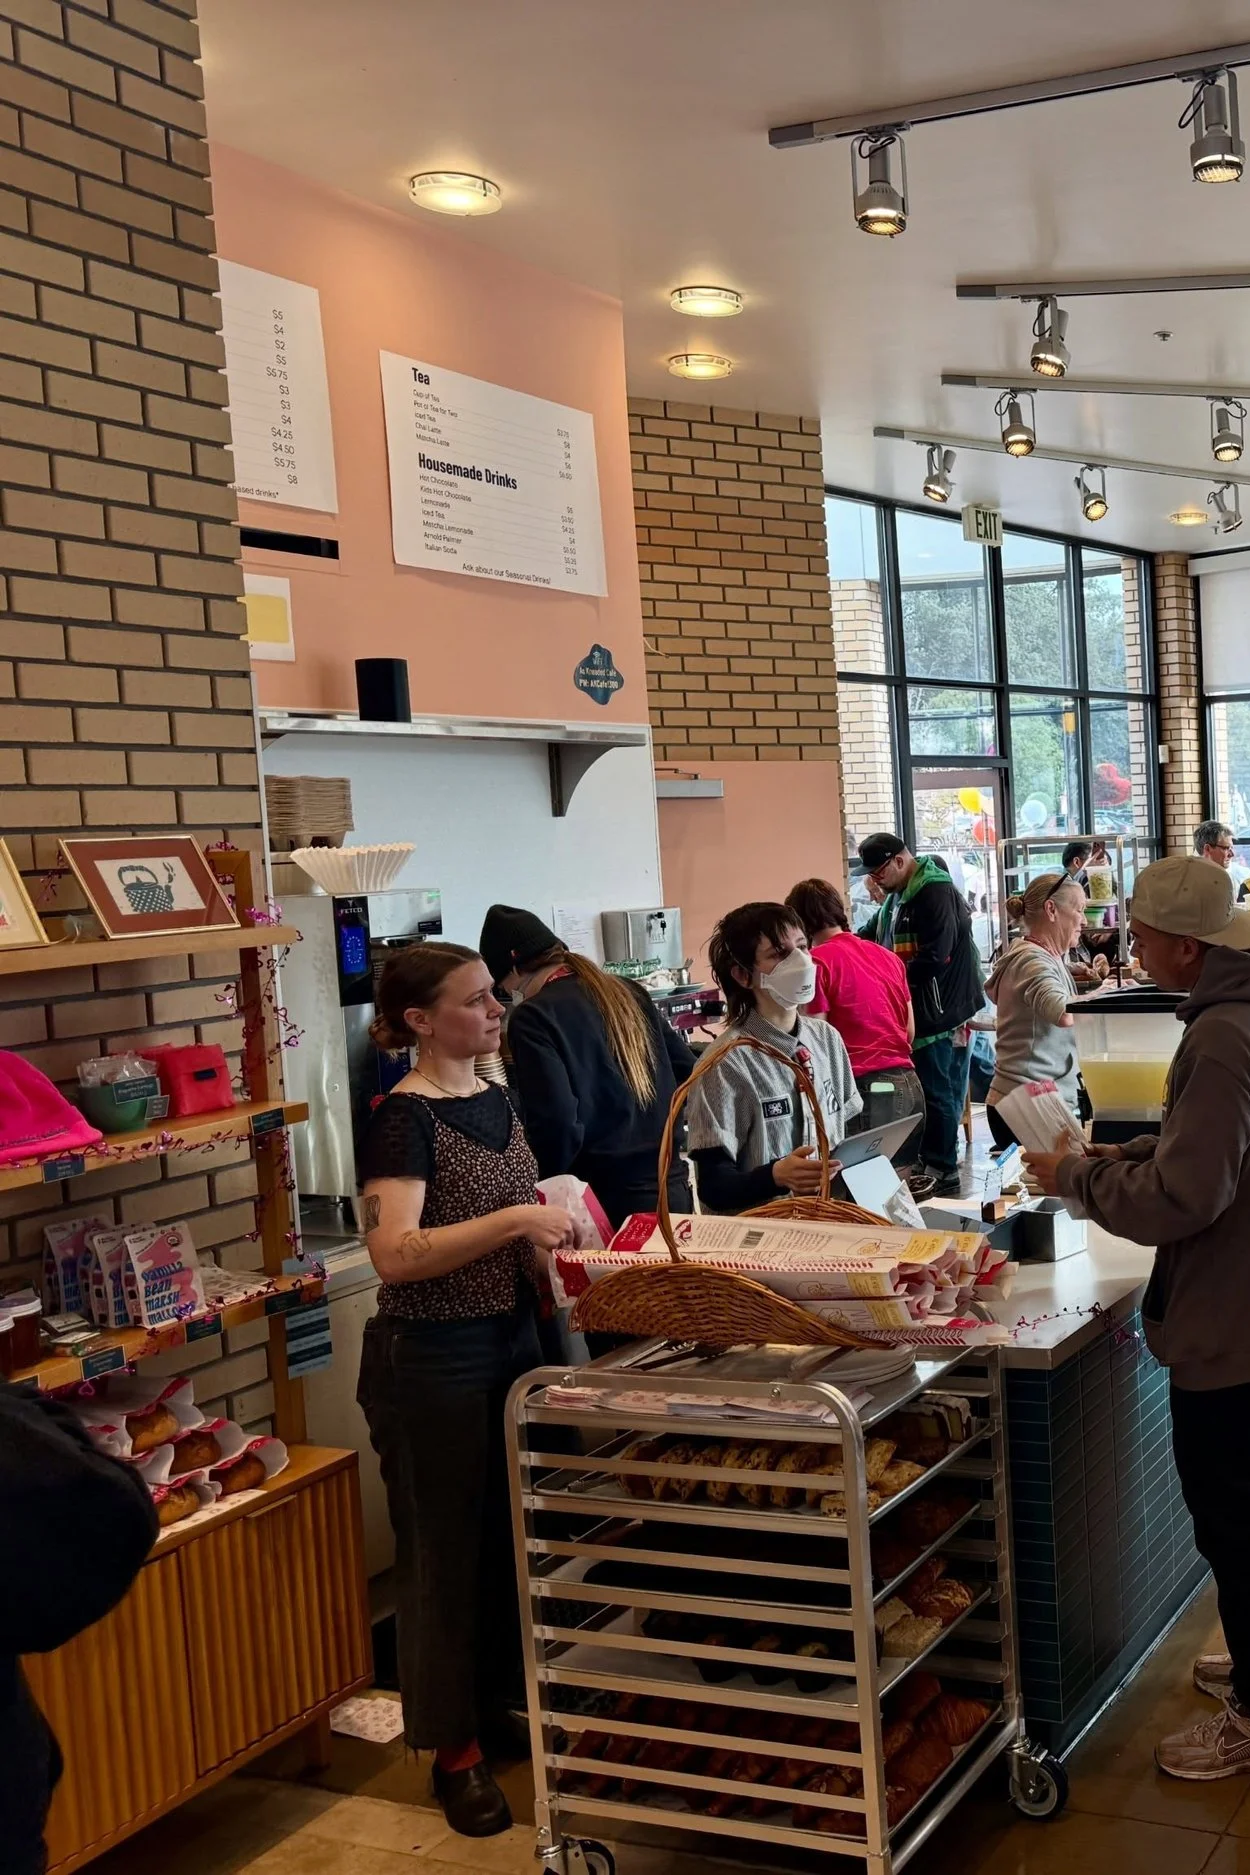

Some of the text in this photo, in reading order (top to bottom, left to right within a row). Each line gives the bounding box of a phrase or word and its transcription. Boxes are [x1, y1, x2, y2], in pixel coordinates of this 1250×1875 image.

[272, 309, 283, 320] $5
[273, 324, 284, 335] $4
[275, 339, 285, 350] $2
[276, 354, 287, 366] $5
[412, 367, 430, 385] Tea
[279, 384, 290, 395] $3
[281, 399, 291, 410] $3
[281, 414, 292, 425] $4
[418, 452, 518, 490] Housemade Drinks
[975, 510, 998, 541] EXIT
